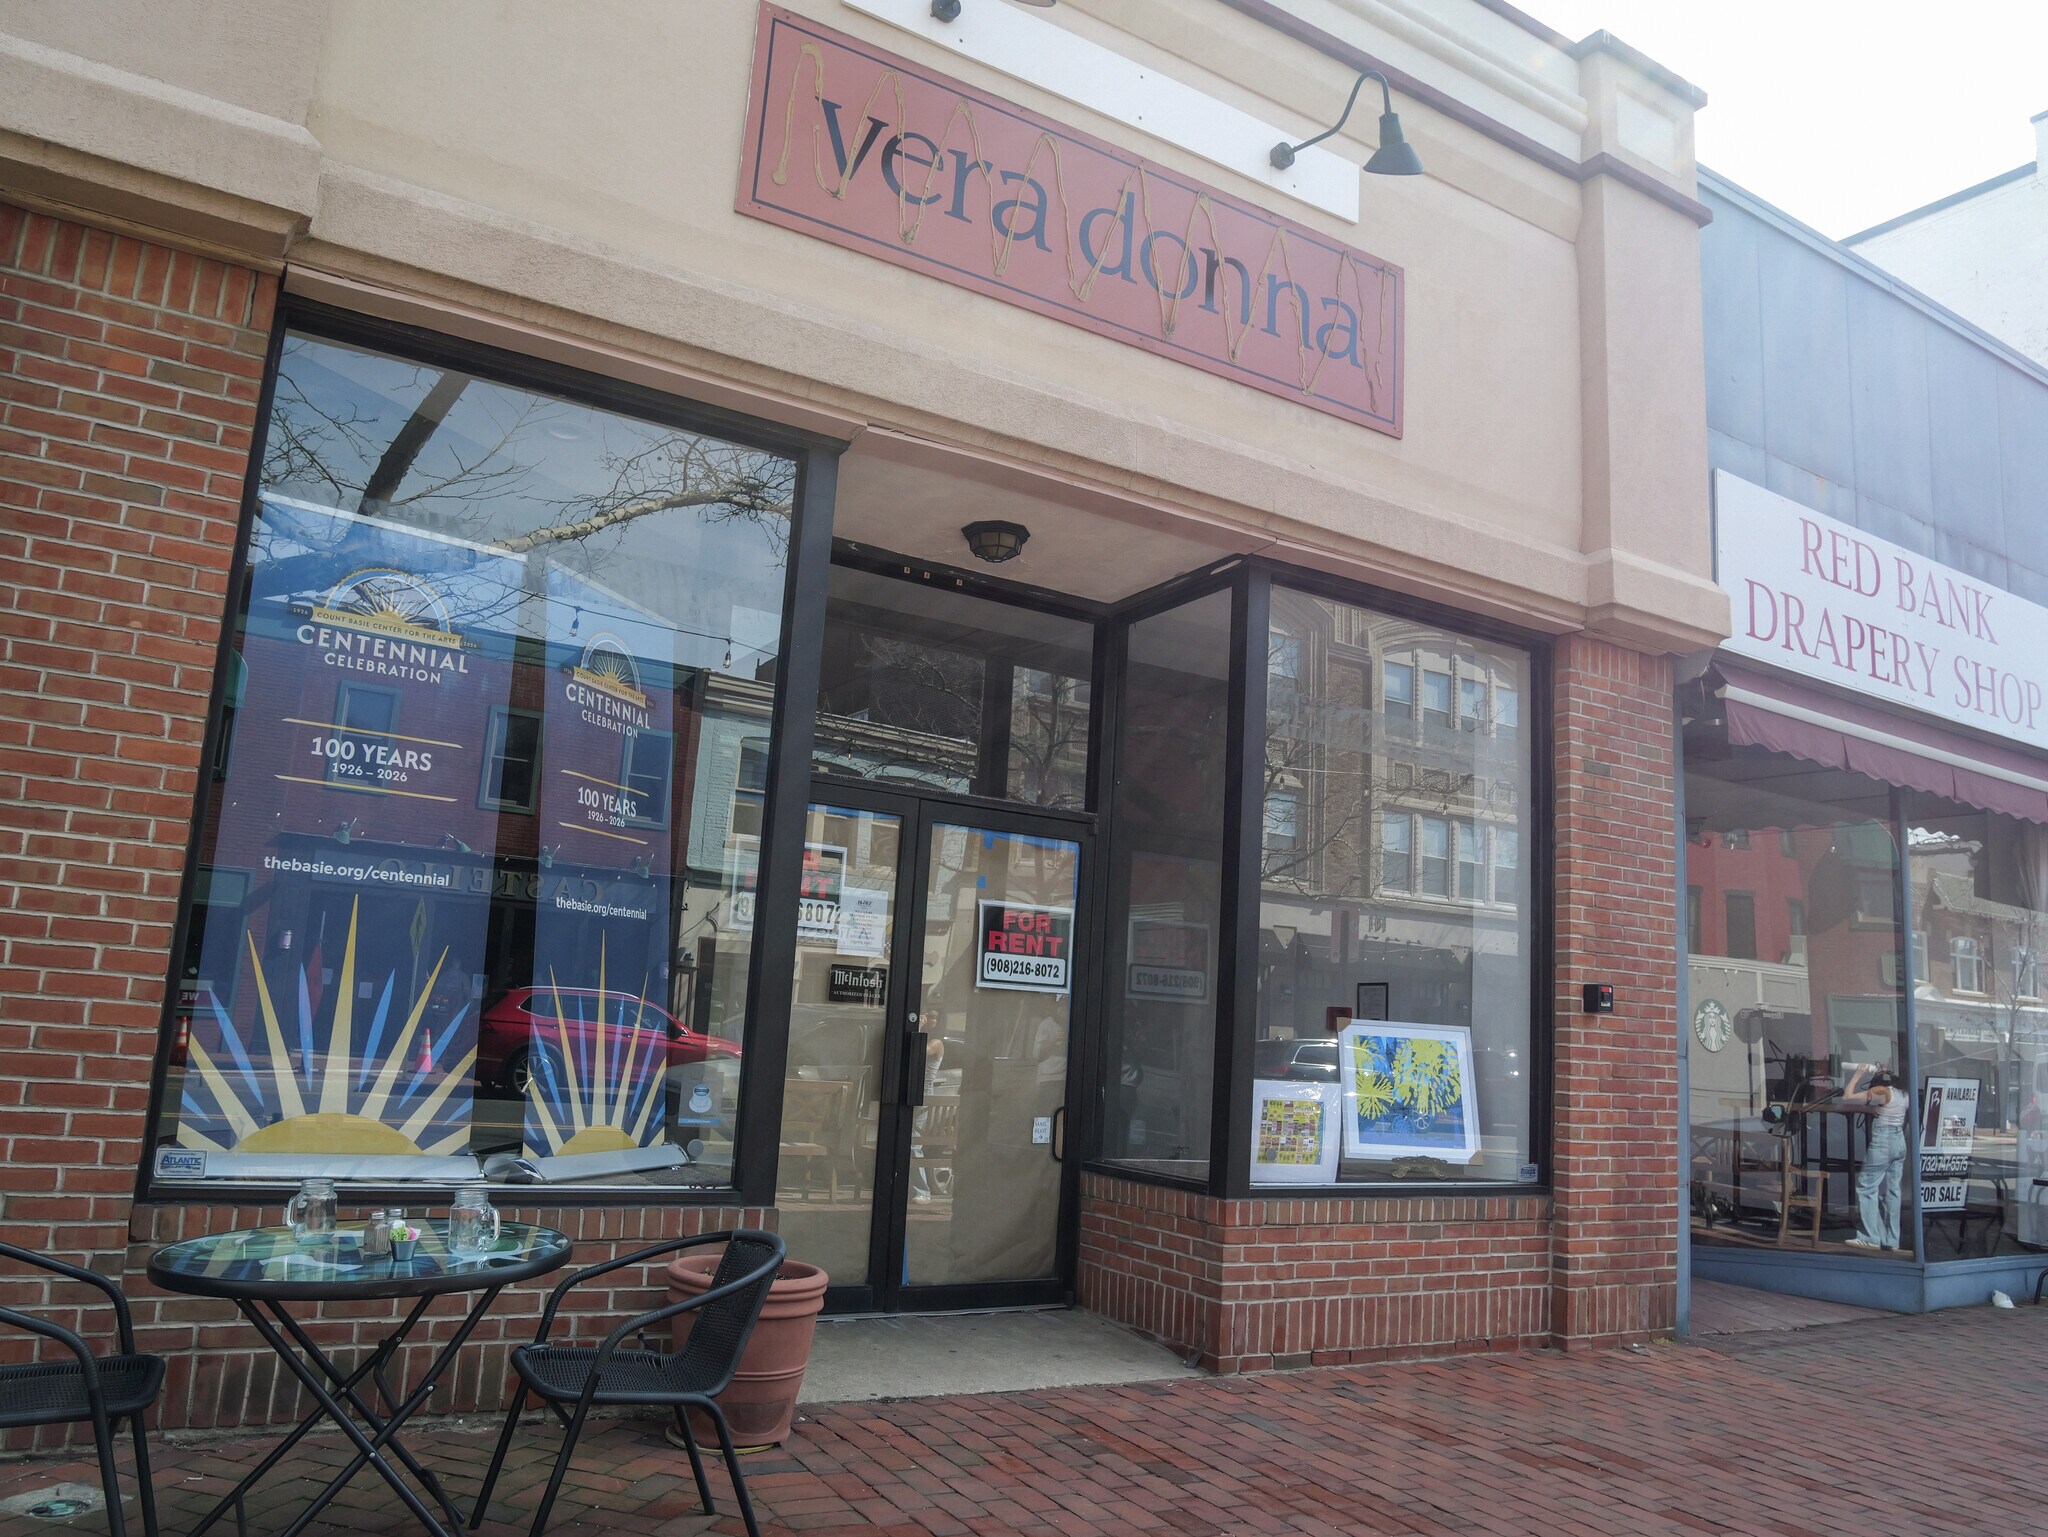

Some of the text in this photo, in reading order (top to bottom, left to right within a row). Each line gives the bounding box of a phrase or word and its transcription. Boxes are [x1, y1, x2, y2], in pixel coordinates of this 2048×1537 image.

[815, 96, 1363, 369] vera donna
[1799, 517, 1999, 645] RED BANK
[317, 612, 345, 623] COUNT
[348, 618, 370, 628] BASIE
[372, 622, 402, 633] CENTER
[404, 628, 420, 637] FOR
[422, 632, 436, 641] THE
[438, 636, 457, 645] ARTS
[296, 624, 469, 674] CENTENNIAL
[1744, 577, 2042, 730] DRAPERY SHOP
[324, 653, 441, 684] CELEBRATION
[565, 683, 650, 730] CENTENNIAL
[581, 709, 638, 739] CELEBRATION
[311, 736, 432, 772] 100 YEARS
[332, 762, 363, 777] 1926
[377, 768, 408, 782] 2026
[577, 787, 637, 818] 100 YEARS
[587, 810, 604, 823] 1926
[609, 816, 625, 828] 2026
[263, 855, 450, 887] thebasie.org/centennial
[556, 896, 647, 921] thebasie.org/centennial
[1003, 910, 1051, 934] FOR
[988, 930, 1064, 957] RENT
[834, 970, 884, 988] McIntosh
[986, 957, 1059, 979] (908)216-8072
[1946, 1088, 1976, 1101] AVAILABLE
[1939, 1186, 1962, 1202] SALE
